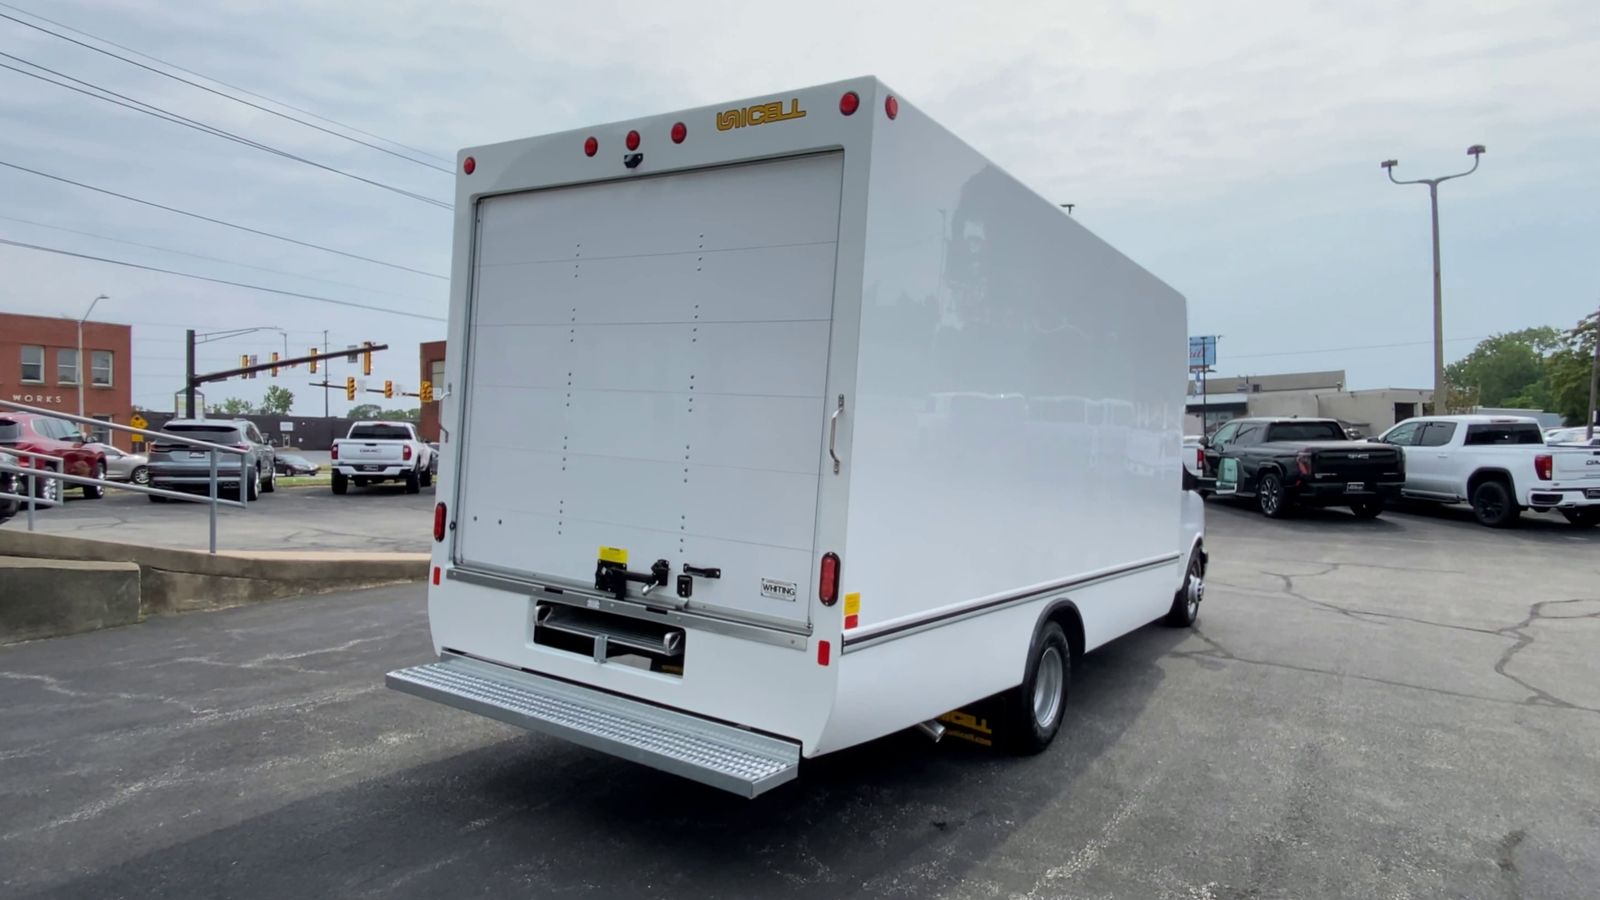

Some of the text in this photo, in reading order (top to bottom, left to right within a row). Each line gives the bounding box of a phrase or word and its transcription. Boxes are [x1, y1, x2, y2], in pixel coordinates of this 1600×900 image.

[716, 98, 807, 131] UNICELL
[12, 394, 62, 403] WORKS
[762, 583, 796, 596] WHITING
